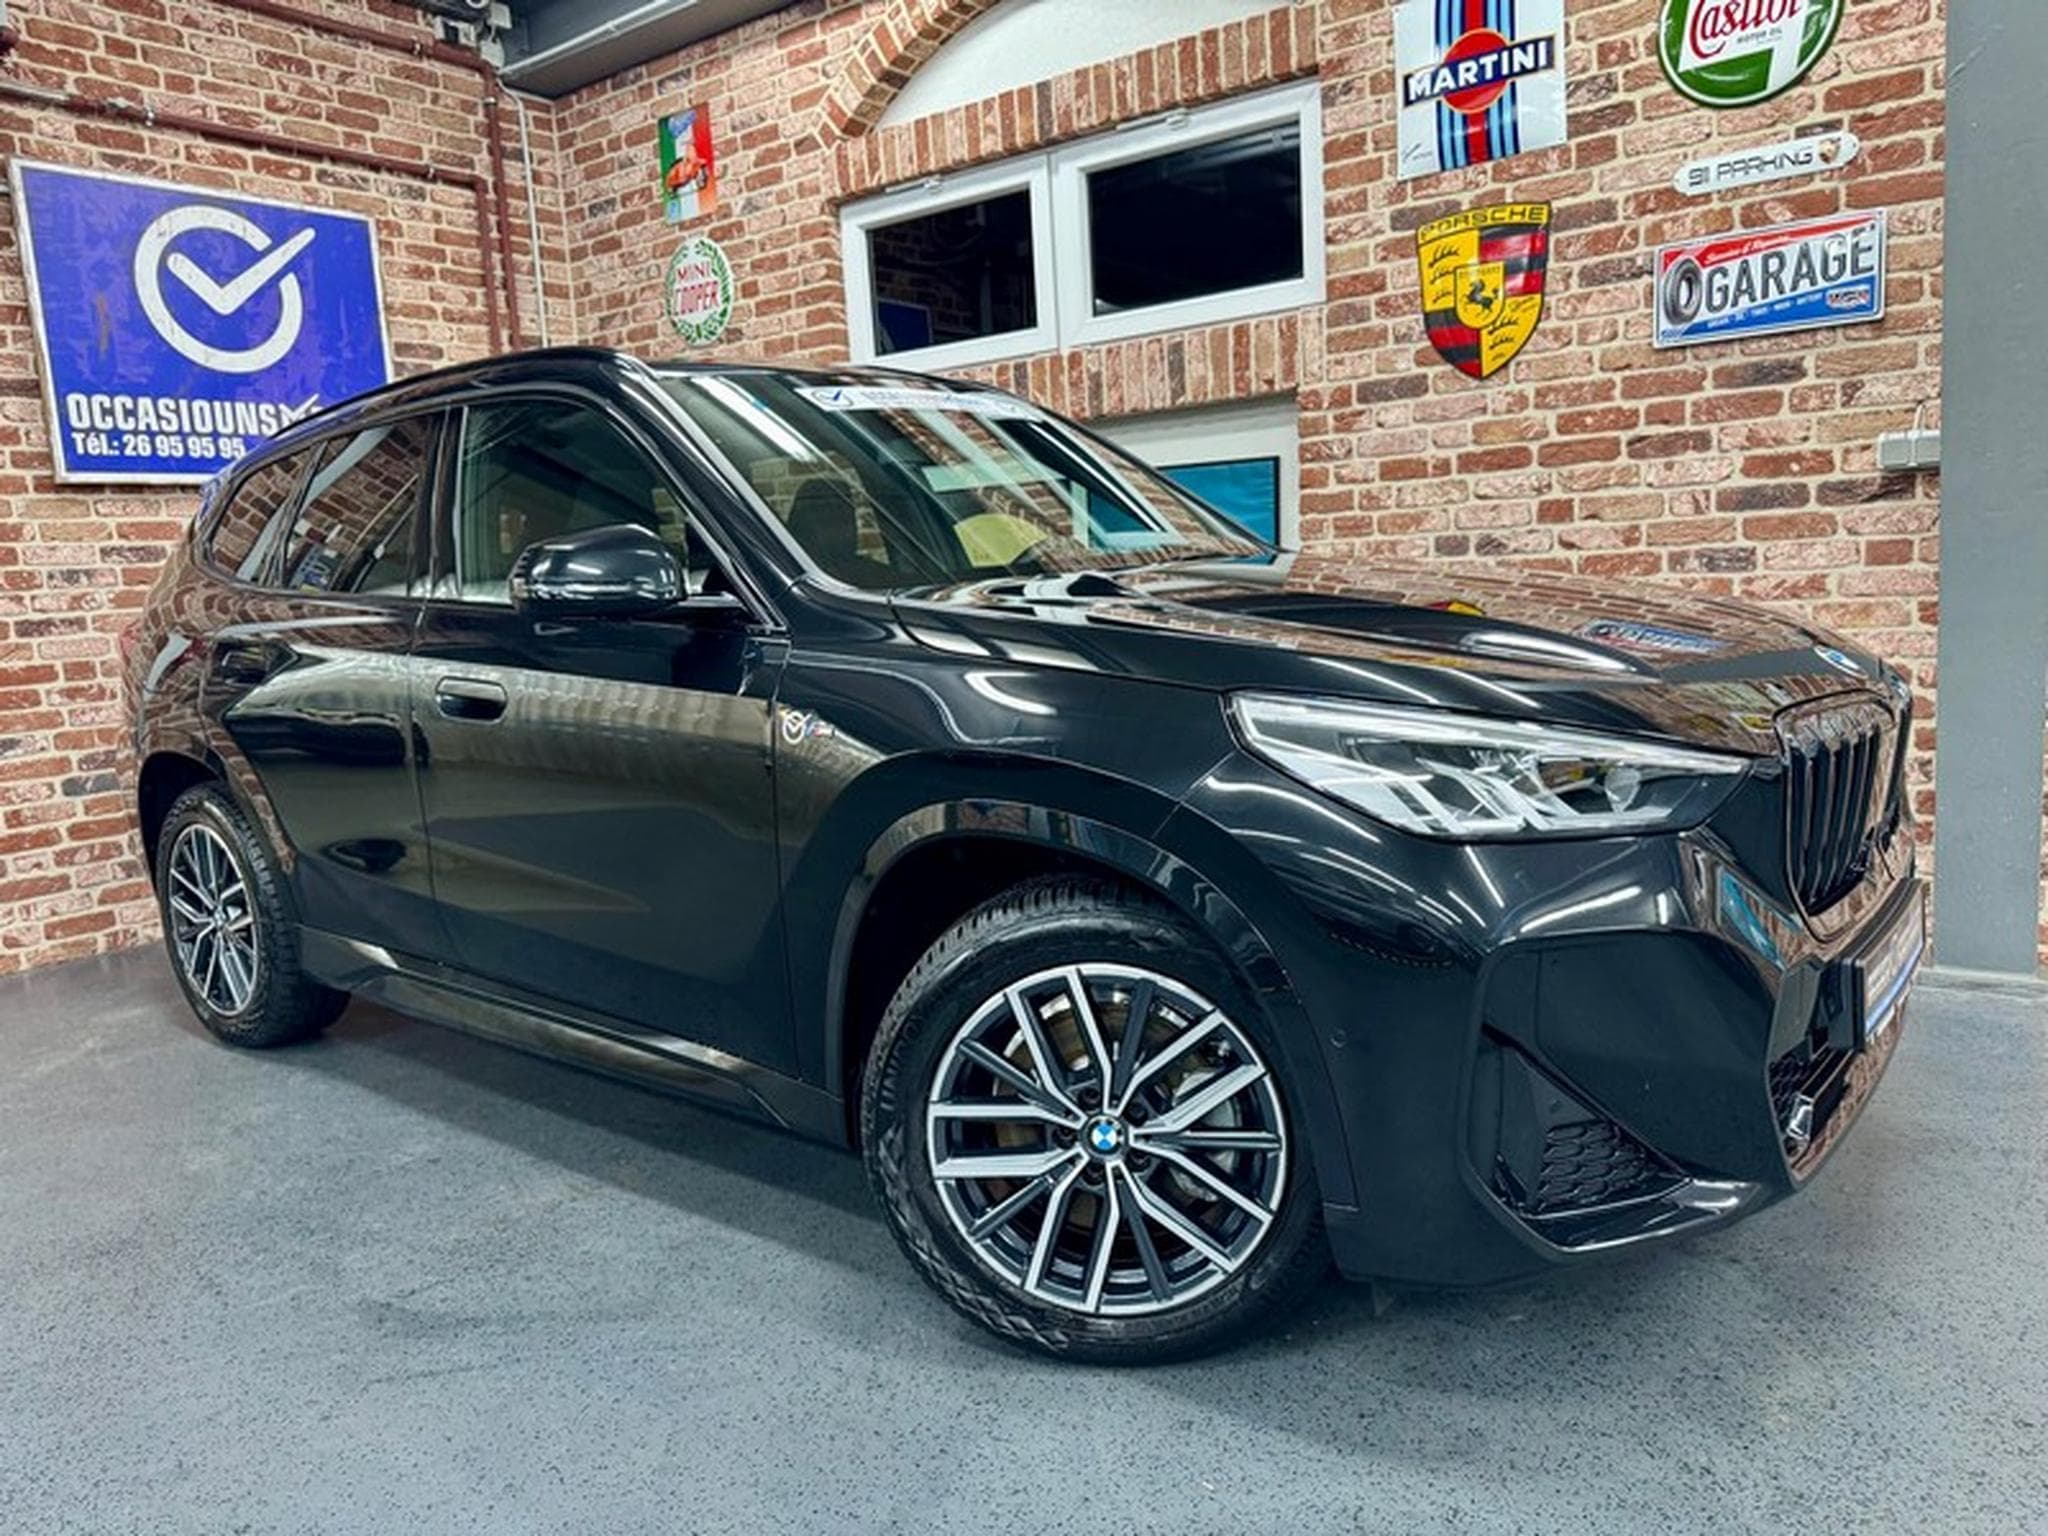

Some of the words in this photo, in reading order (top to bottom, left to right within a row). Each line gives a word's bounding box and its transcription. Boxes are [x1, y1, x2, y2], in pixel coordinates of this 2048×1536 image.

[1407, 40, 1548, 101] MARTINI
[1716, 145, 1814, 182] PARKING
[1419, 206, 1545, 241] PORSCHE
[1705, 222, 1876, 314] GARAGE
[71, 431, 120, 457] Tél.:
[122, 434, 151, 458] 26
[154, 436, 184, 459] 95
[187, 436, 216, 459] 95
[218, 436, 246, 460] 95
